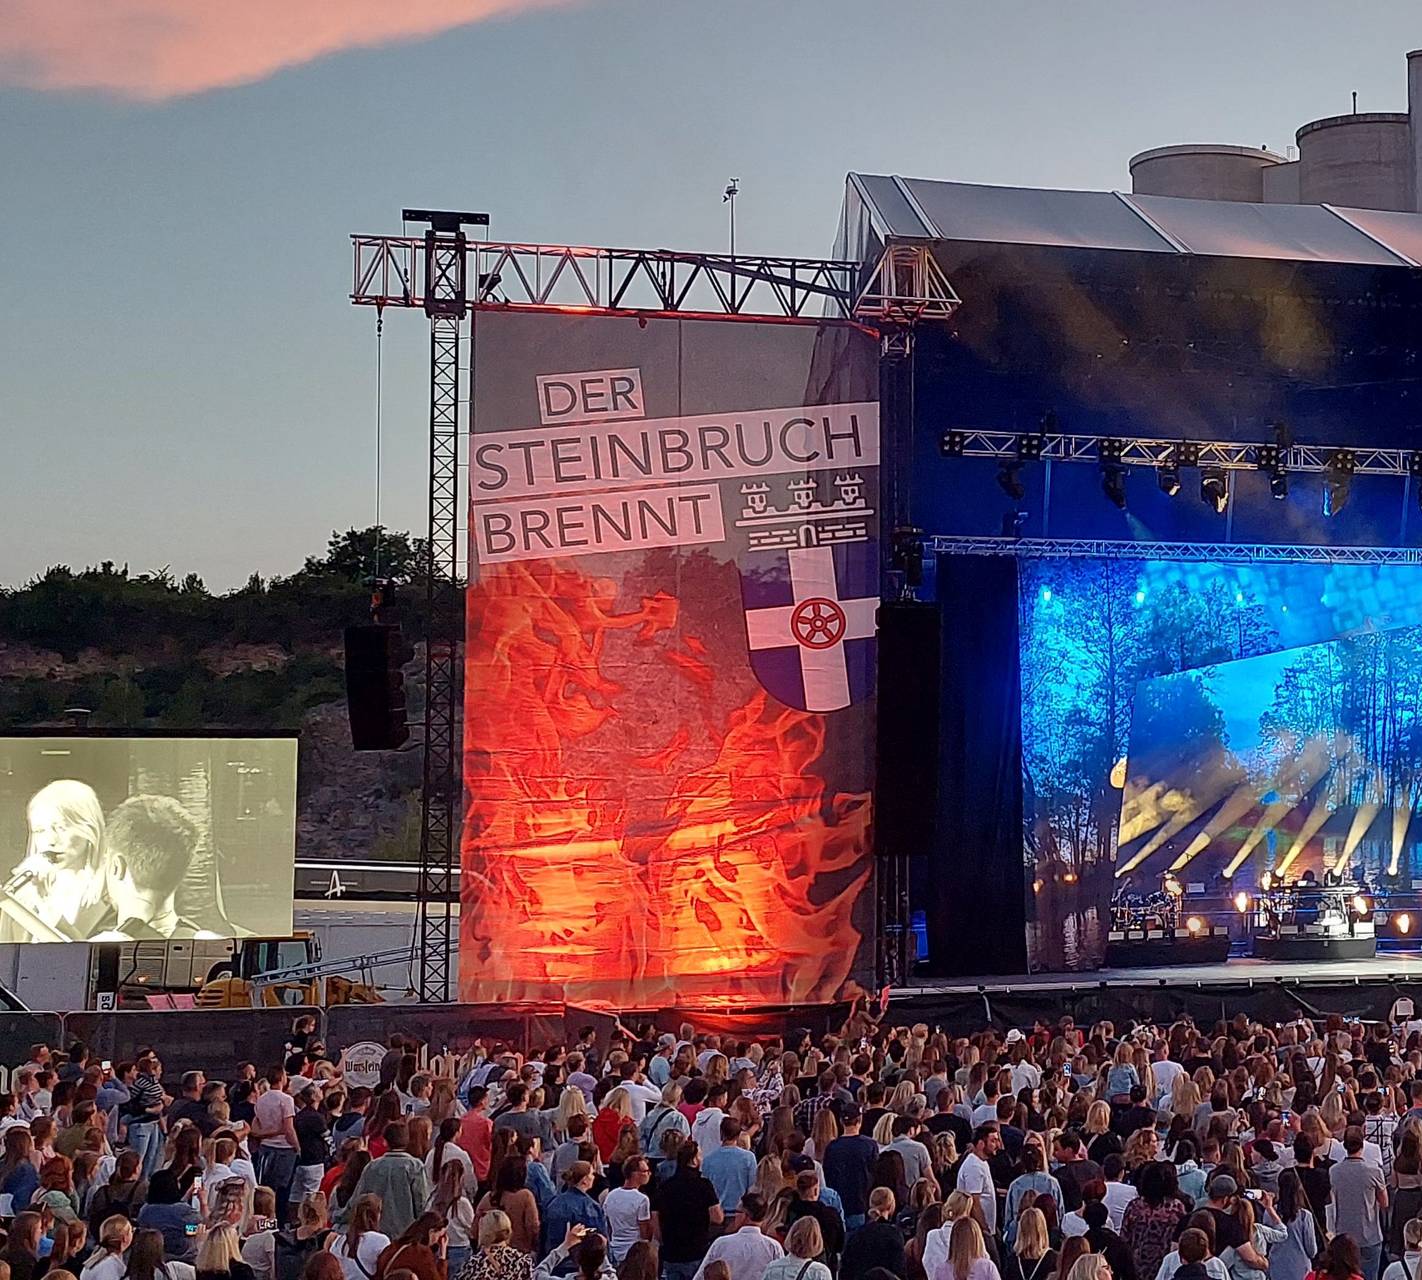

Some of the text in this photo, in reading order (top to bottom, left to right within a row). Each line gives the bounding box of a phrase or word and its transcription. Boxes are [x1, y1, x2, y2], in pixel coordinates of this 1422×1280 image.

[543, 377, 638, 416] DER
[476, 414, 862, 490] STEINBRUCH
[483, 494, 711, 554] BRENNT
